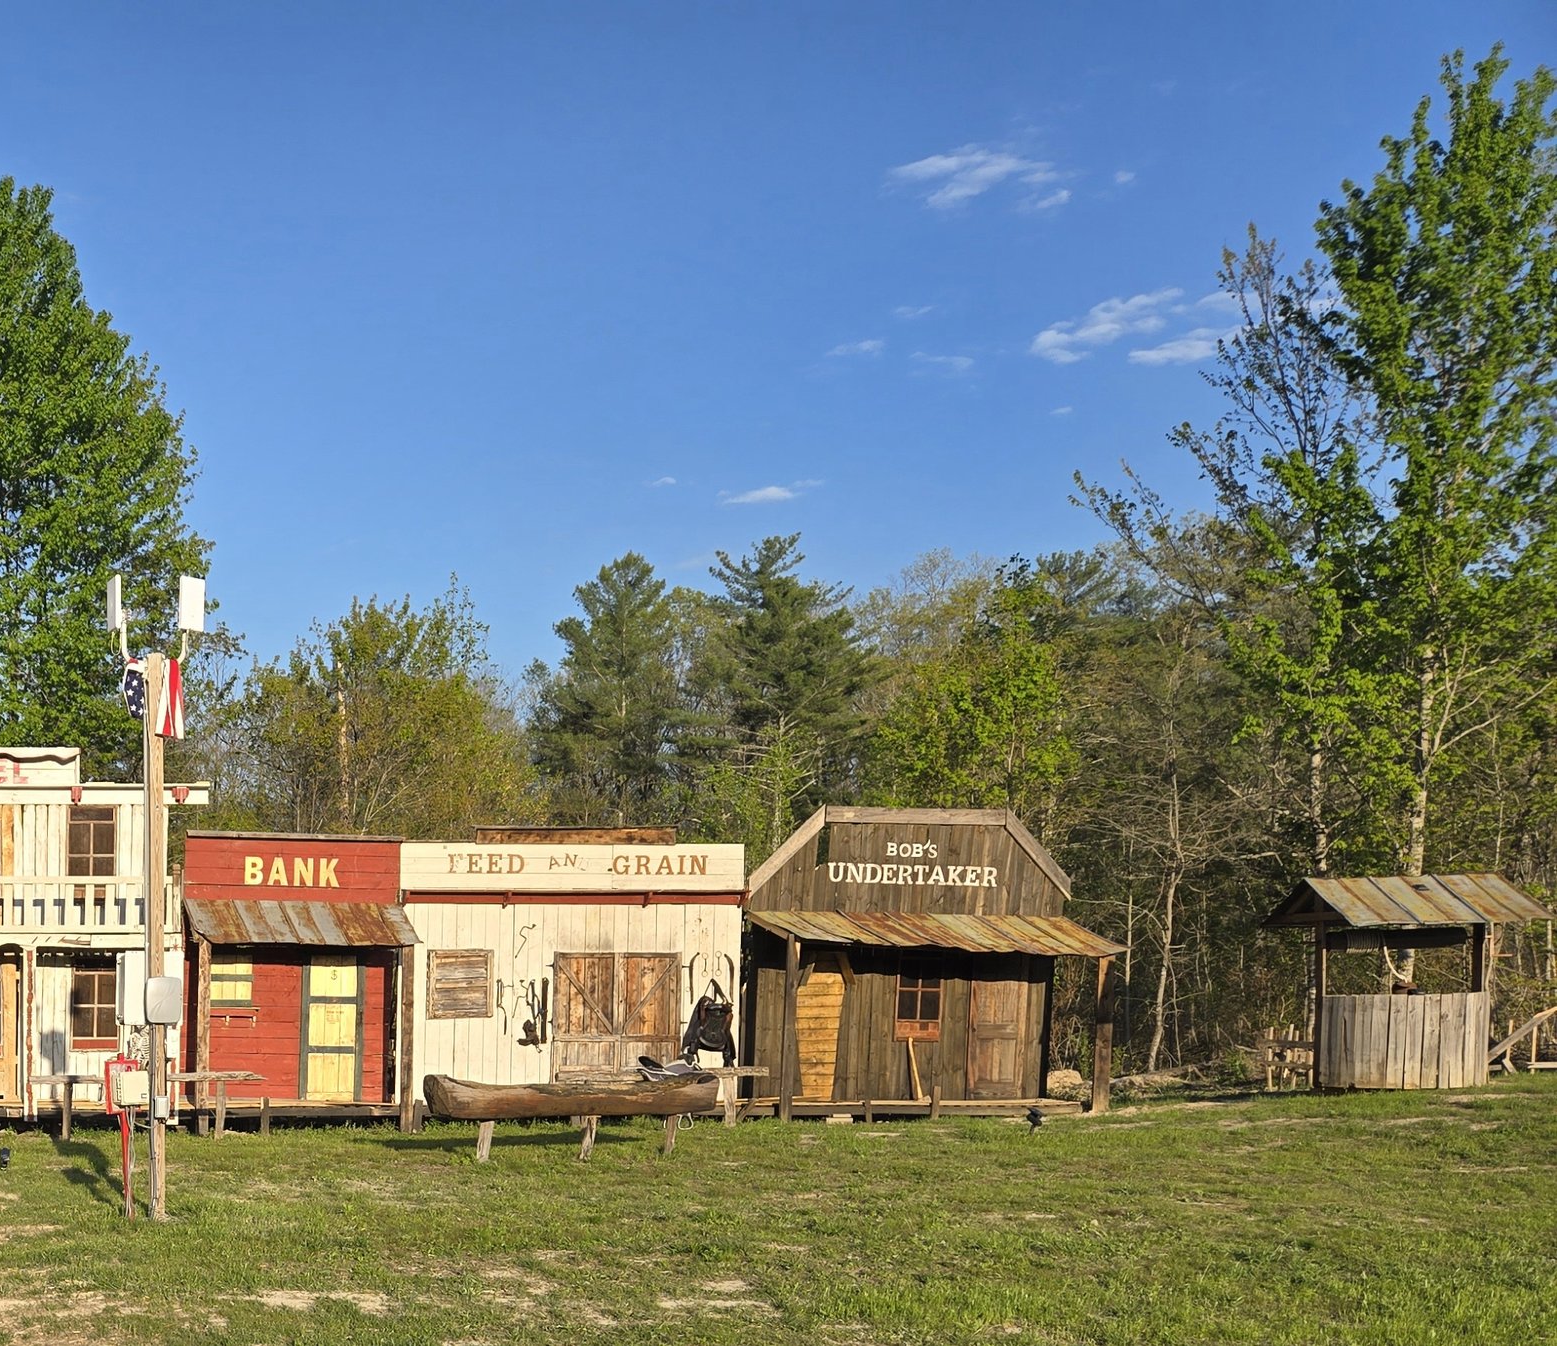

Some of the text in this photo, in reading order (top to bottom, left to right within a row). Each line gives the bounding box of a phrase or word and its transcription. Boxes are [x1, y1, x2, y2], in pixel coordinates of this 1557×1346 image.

[885, 838, 939, 860] BOB'S
[243, 855, 341, 888] BANK
[447, 853, 525, 875] FEED
[611, 854, 709, 876] GRAIN
[827, 861, 999, 888] UNDERTAKER
